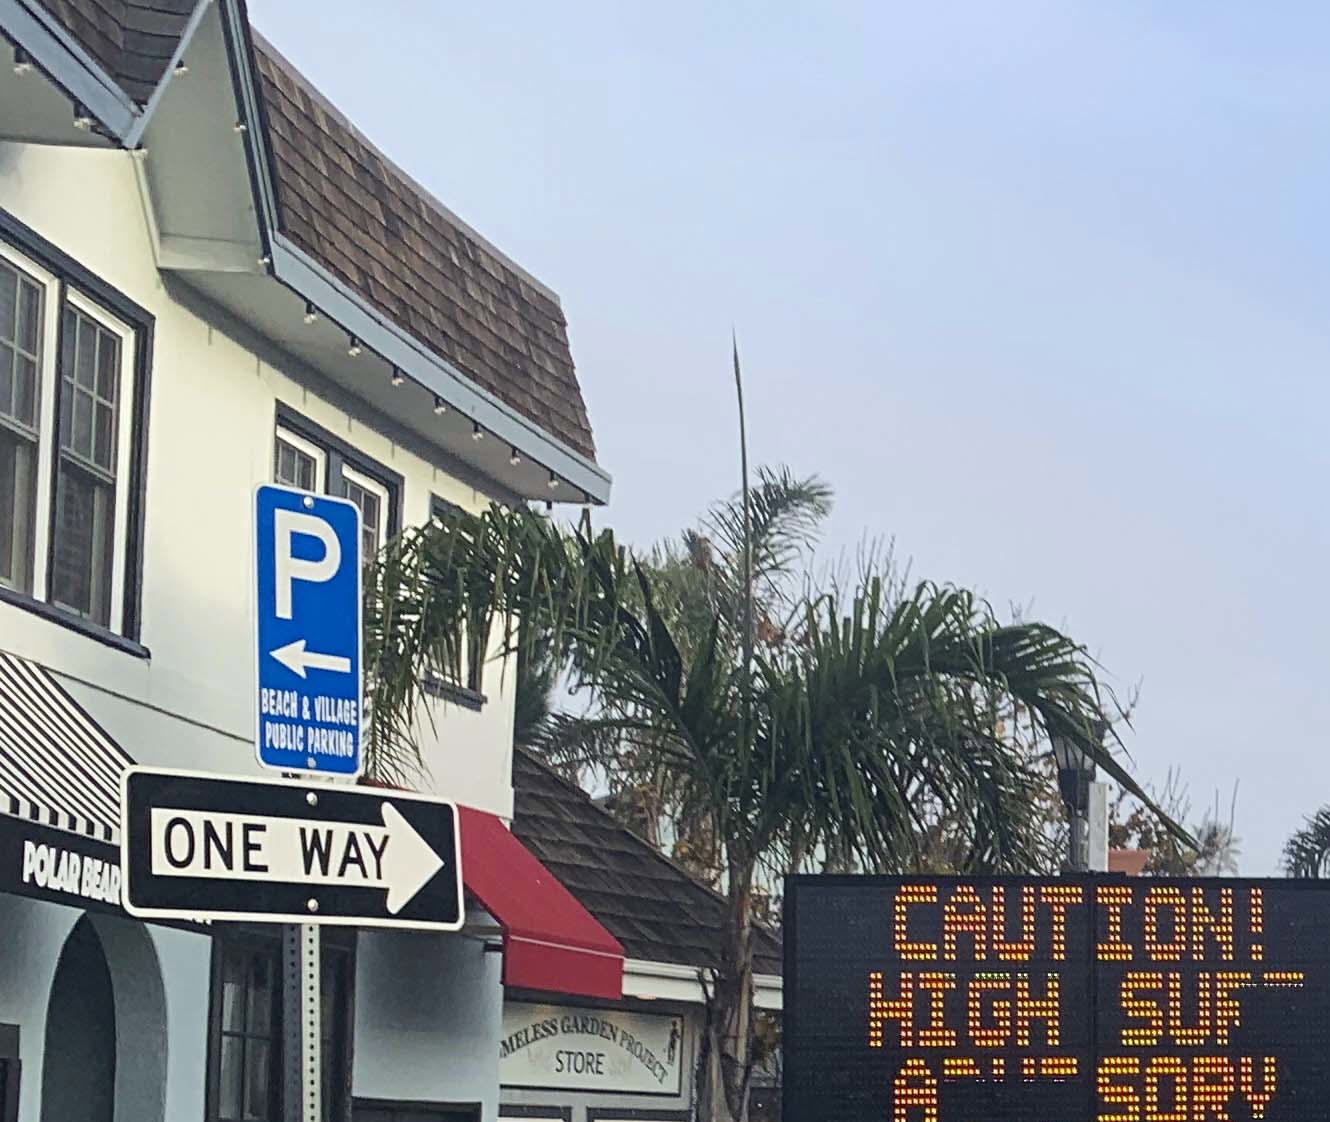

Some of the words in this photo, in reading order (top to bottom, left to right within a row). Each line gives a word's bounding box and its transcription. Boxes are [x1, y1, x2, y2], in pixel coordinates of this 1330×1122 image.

[274, 507, 342, 620] P
[261, 688, 298, 718] BEACH
[302, 695, 311, 720] &
[314, 695, 357, 726] VILLAGE
[265, 721, 304, 752] PUBLIC
[307, 726, 353, 758] PARKING
[23, 840, 81, 894] POLAR
[81, 856, 121, 905] BEAR
[164, 816, 269, 873] ONE
[300, 827, 390, 881] WAY
[894, 884, 1264, 961] CAUTION!
[868, 971, 1060, 1047] HIGH
[555, 1050, 605, 1075] STORE
[561, 1016, 619, 1043] GARDEN
[619, 1031, 668, 1084] PROJECT
